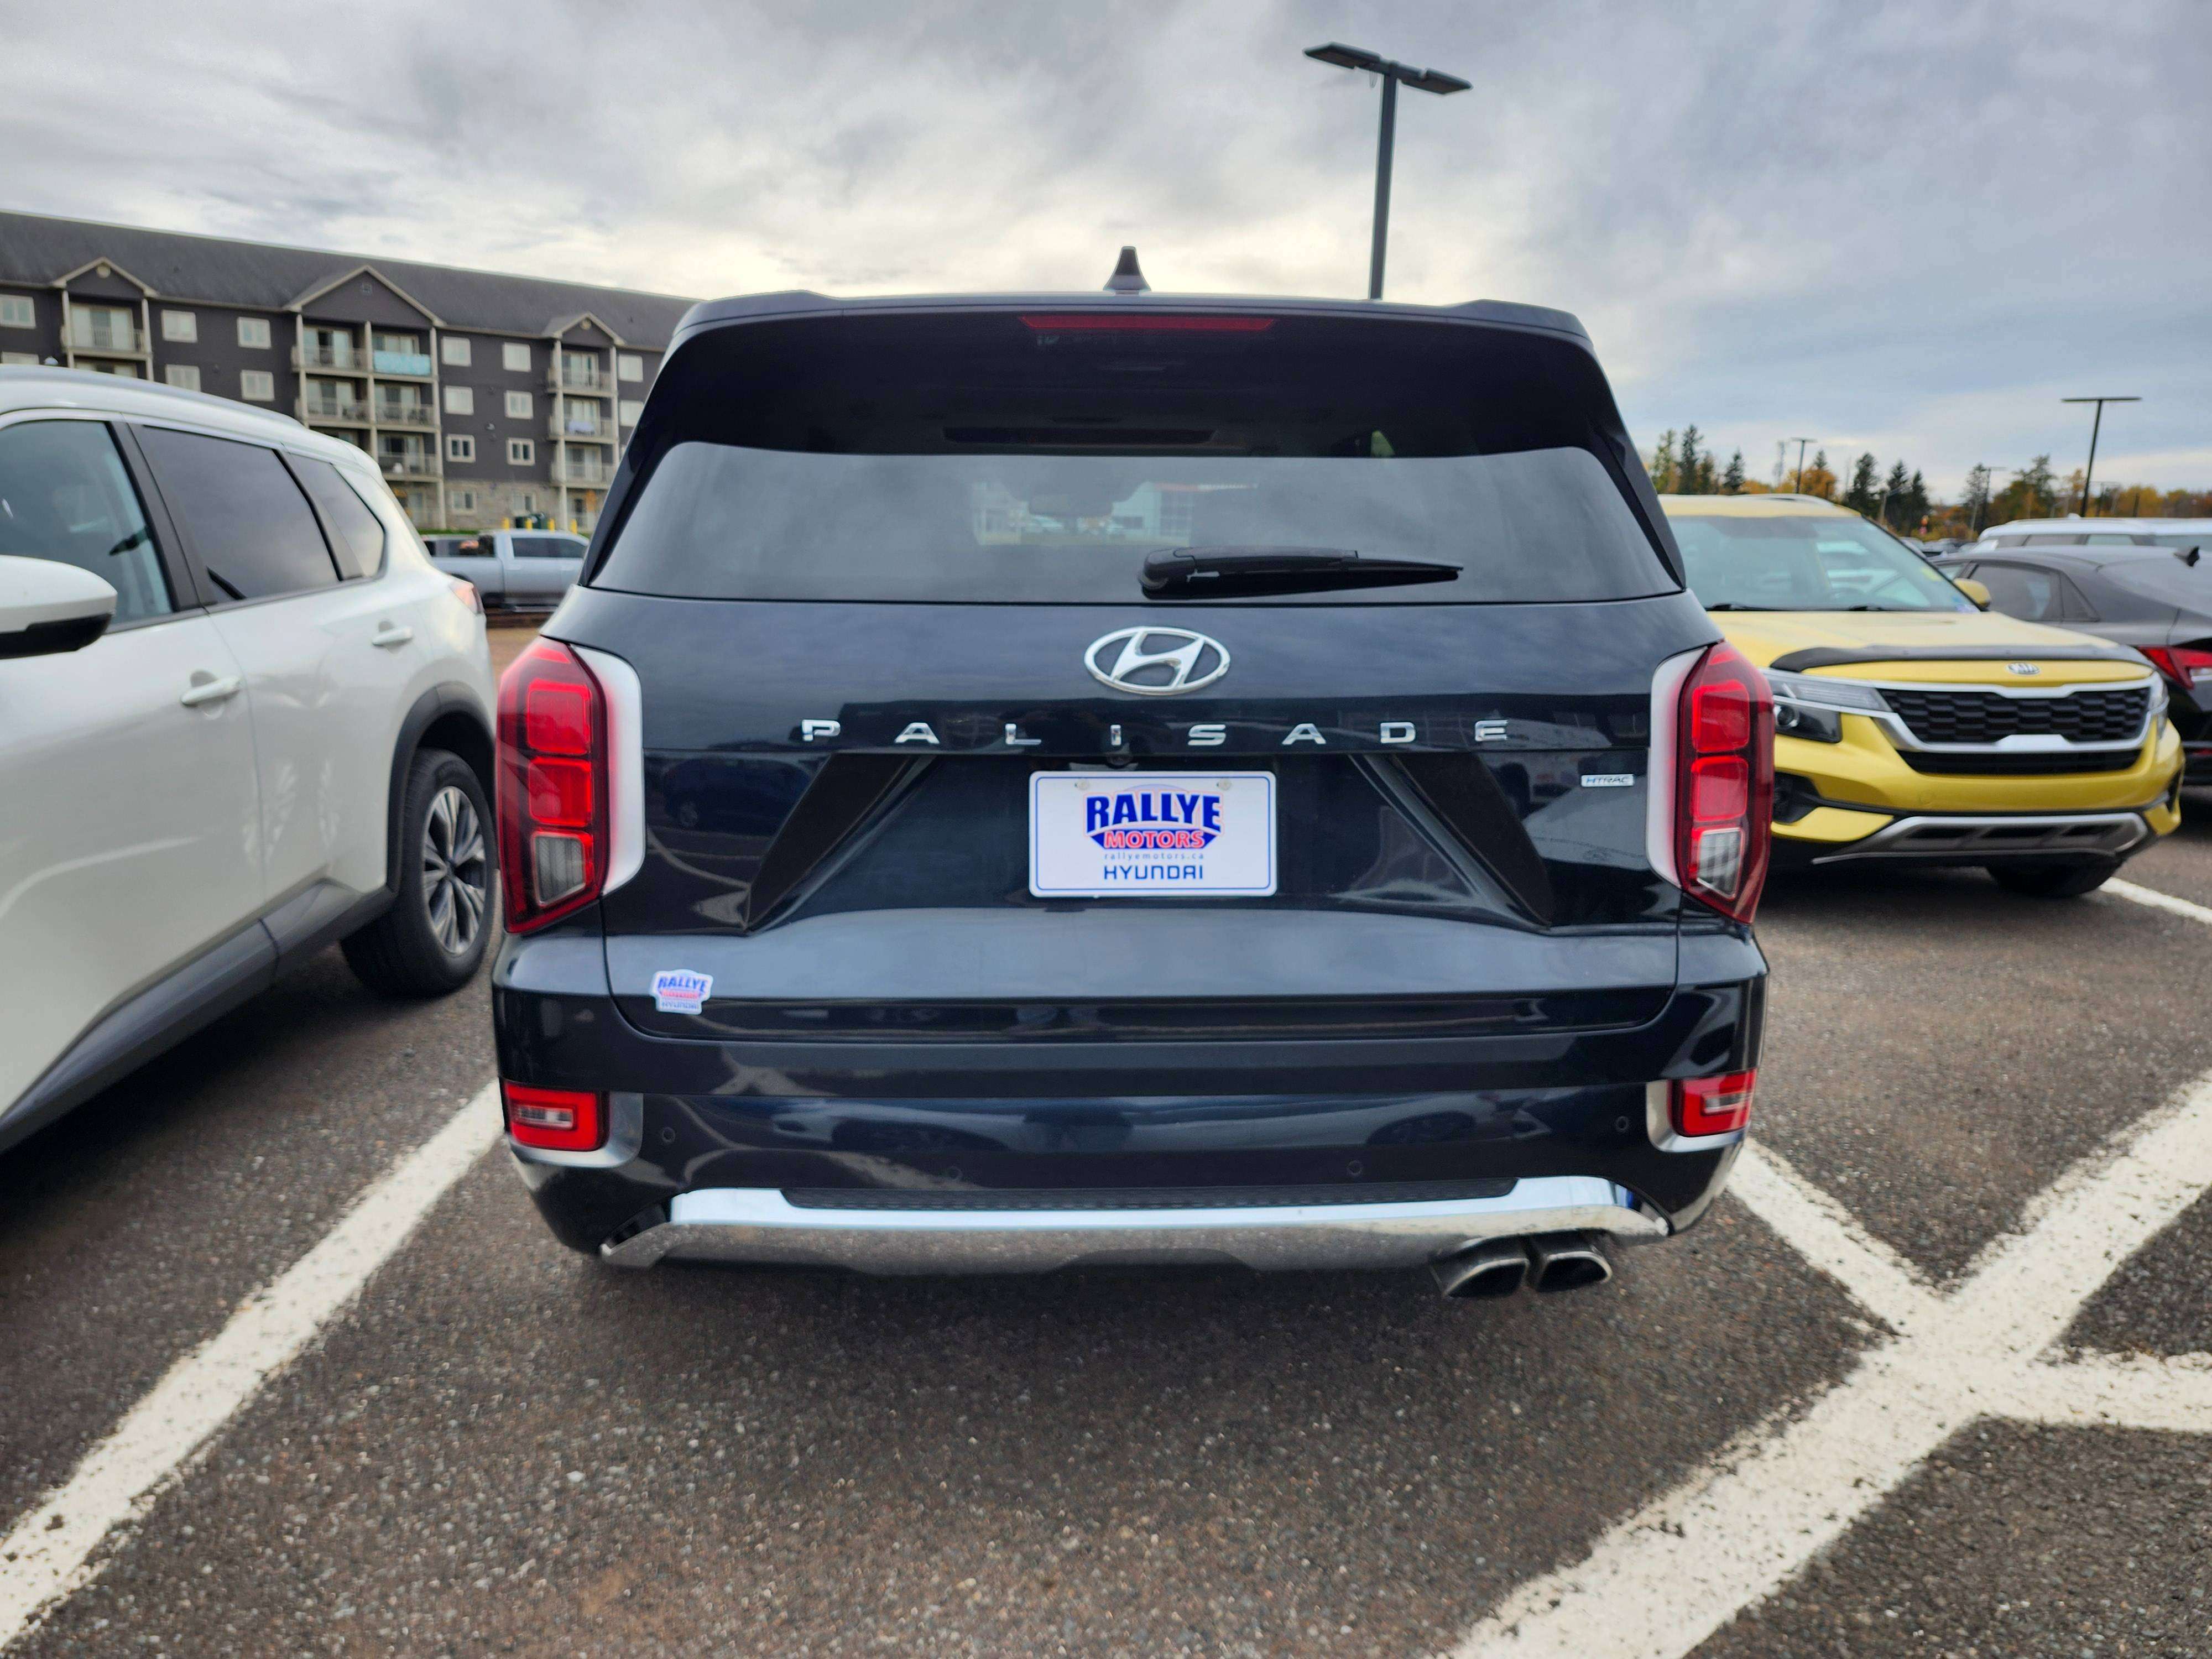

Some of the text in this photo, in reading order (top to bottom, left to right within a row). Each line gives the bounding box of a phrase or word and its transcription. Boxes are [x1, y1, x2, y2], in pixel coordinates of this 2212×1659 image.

[801, 719, 1509, 745] PALISADE
[1086, 793, 1221, 833] RALLYE
[1104, 831, 1205, 848] MOTORS
[1104, 852, 1203, 861] rallyemotors.ca
[1104, 865, 1203, 880] HYUNDAI
[658, 975, 708, 992] RALLYE
